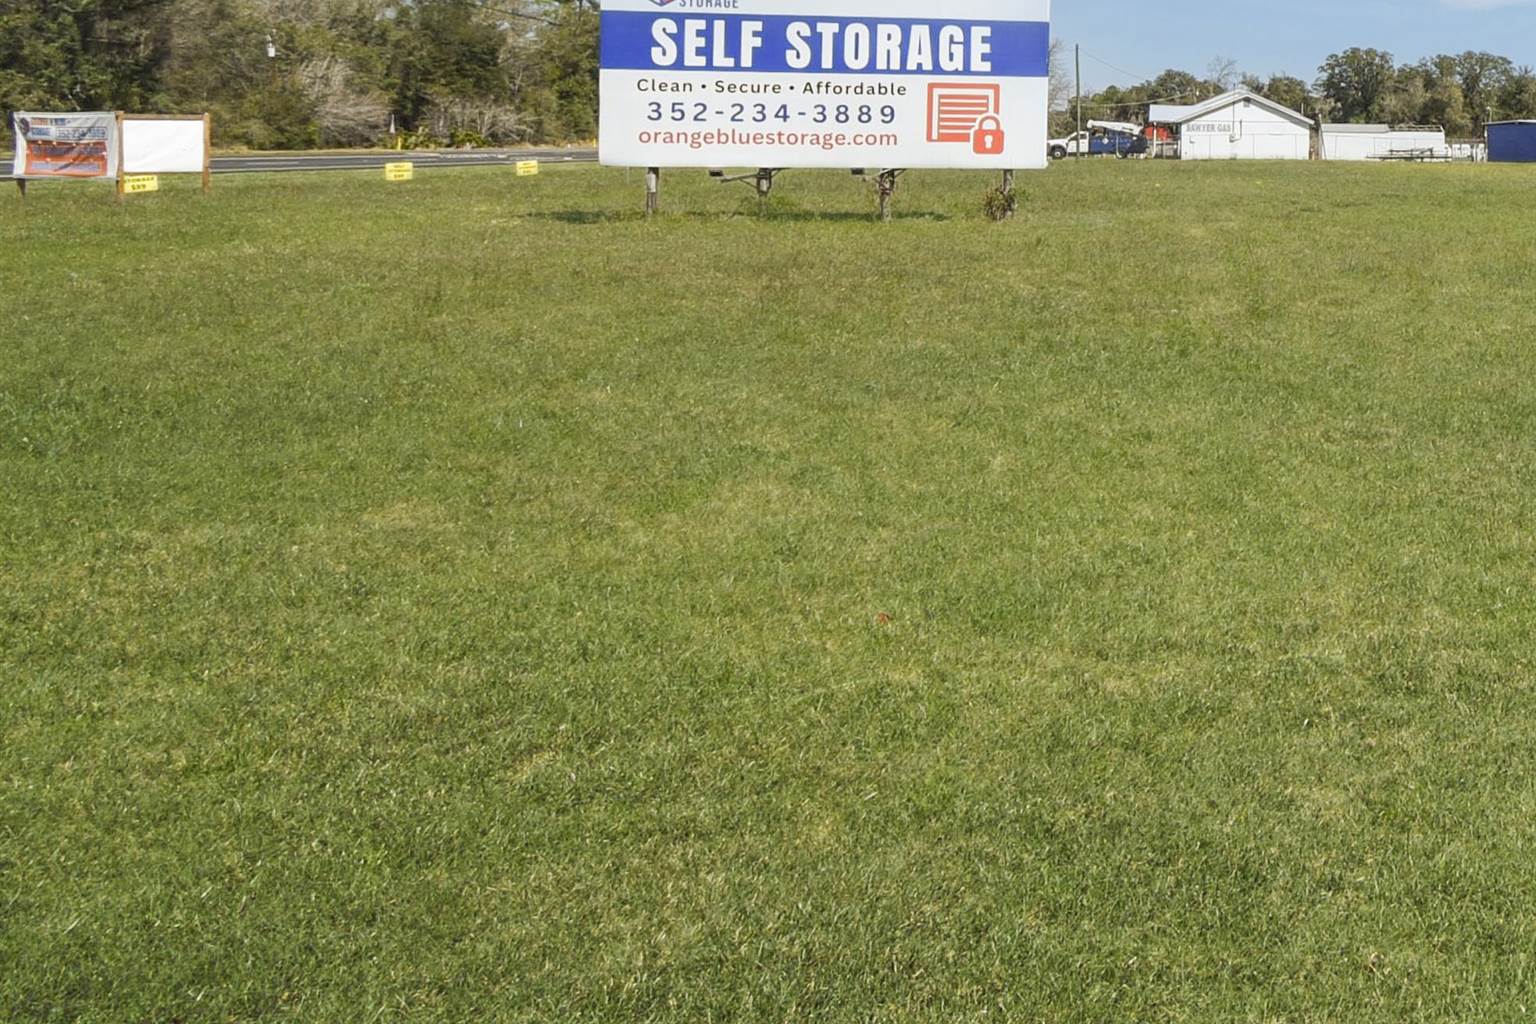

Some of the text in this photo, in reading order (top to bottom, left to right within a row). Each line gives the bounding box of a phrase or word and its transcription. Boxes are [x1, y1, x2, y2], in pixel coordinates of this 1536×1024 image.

[650, 18, 993, 72] SELF STORAGE
[637, 78, 907, 96] Clean Secure Affordable
[646, 101, 896, 125] 352-234-3889
[638, 128, 898, 151] orangebluestorage.com
